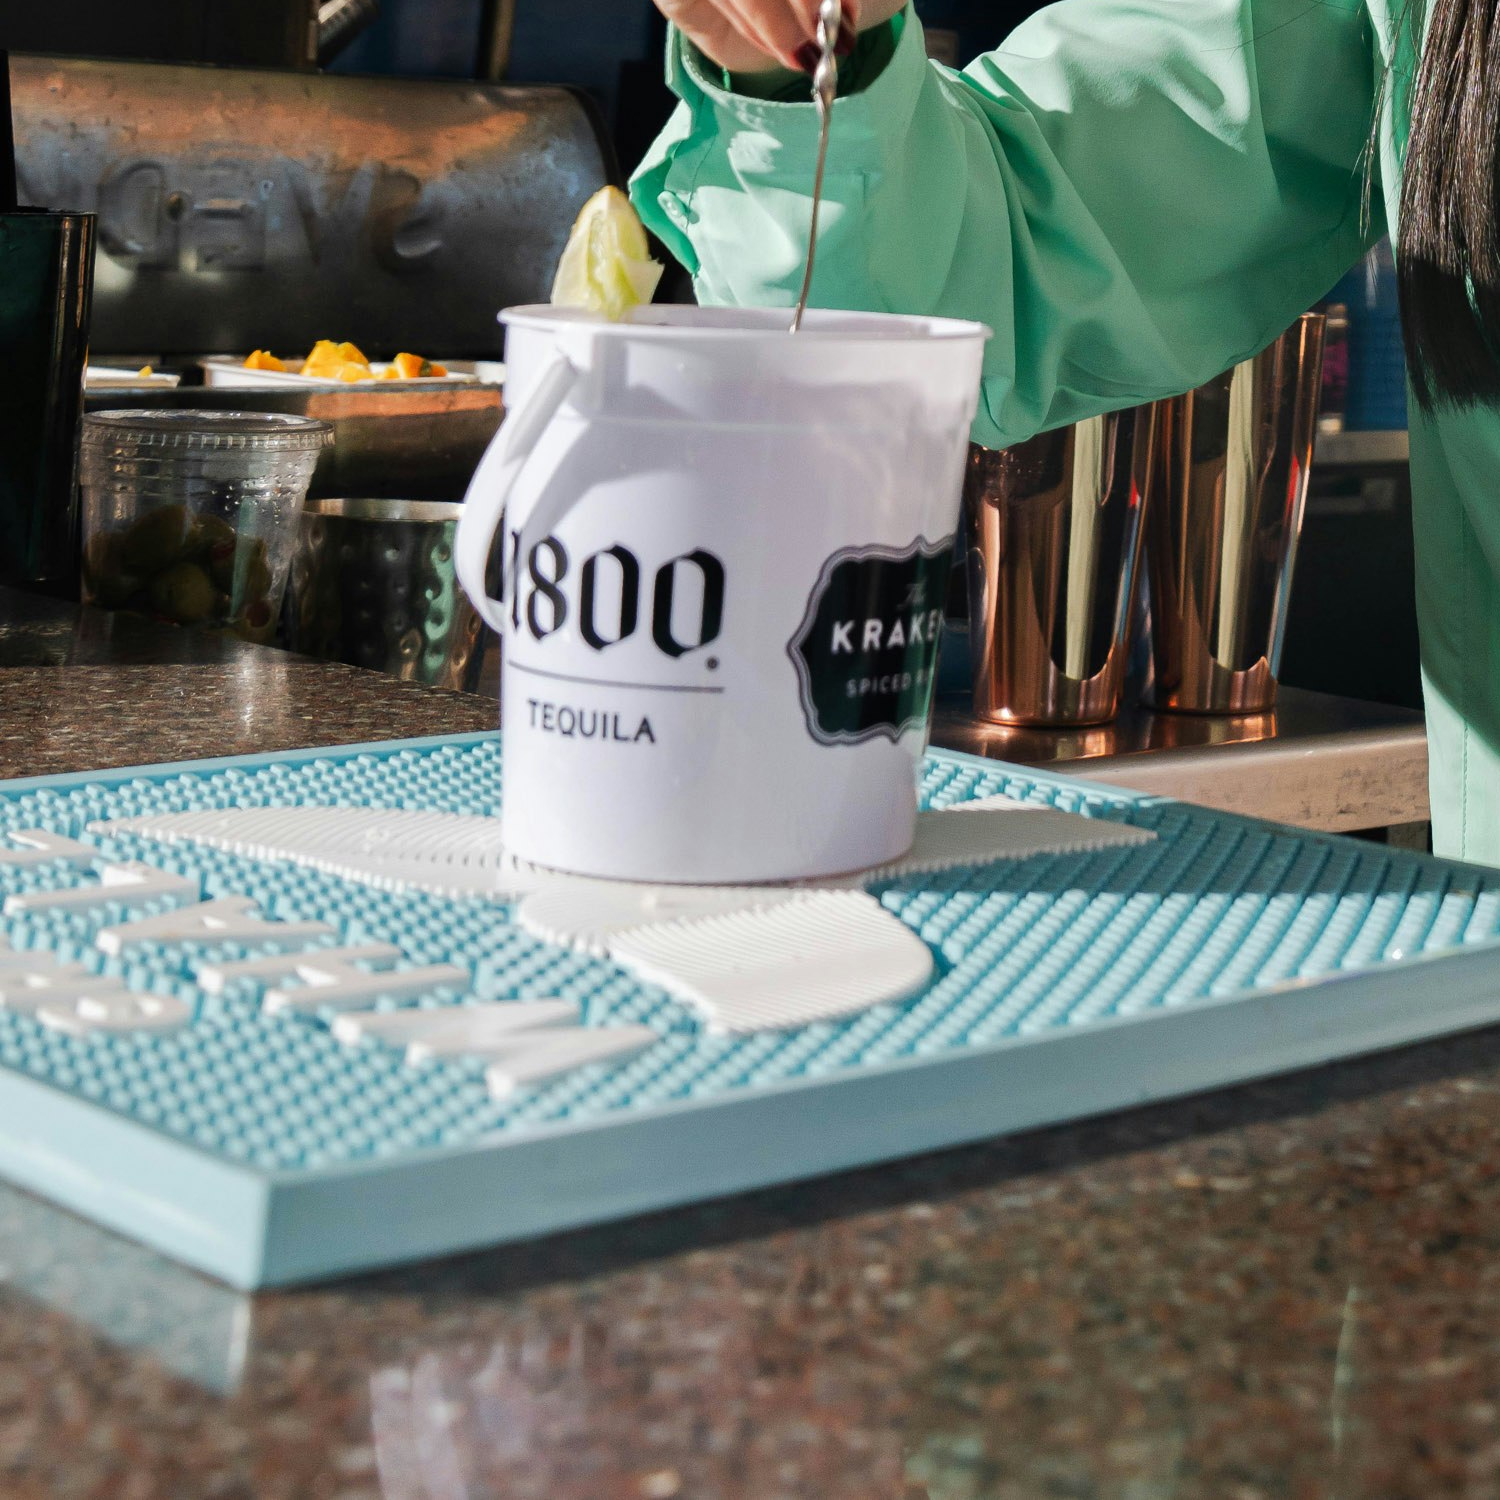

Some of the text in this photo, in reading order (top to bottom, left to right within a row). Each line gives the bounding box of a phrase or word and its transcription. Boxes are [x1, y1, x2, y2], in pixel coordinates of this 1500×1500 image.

[510, 529, 726, 658] 1800
[846, 671, 912, 698] SPICED
[526, 698, 656, 745] TEQUILA
